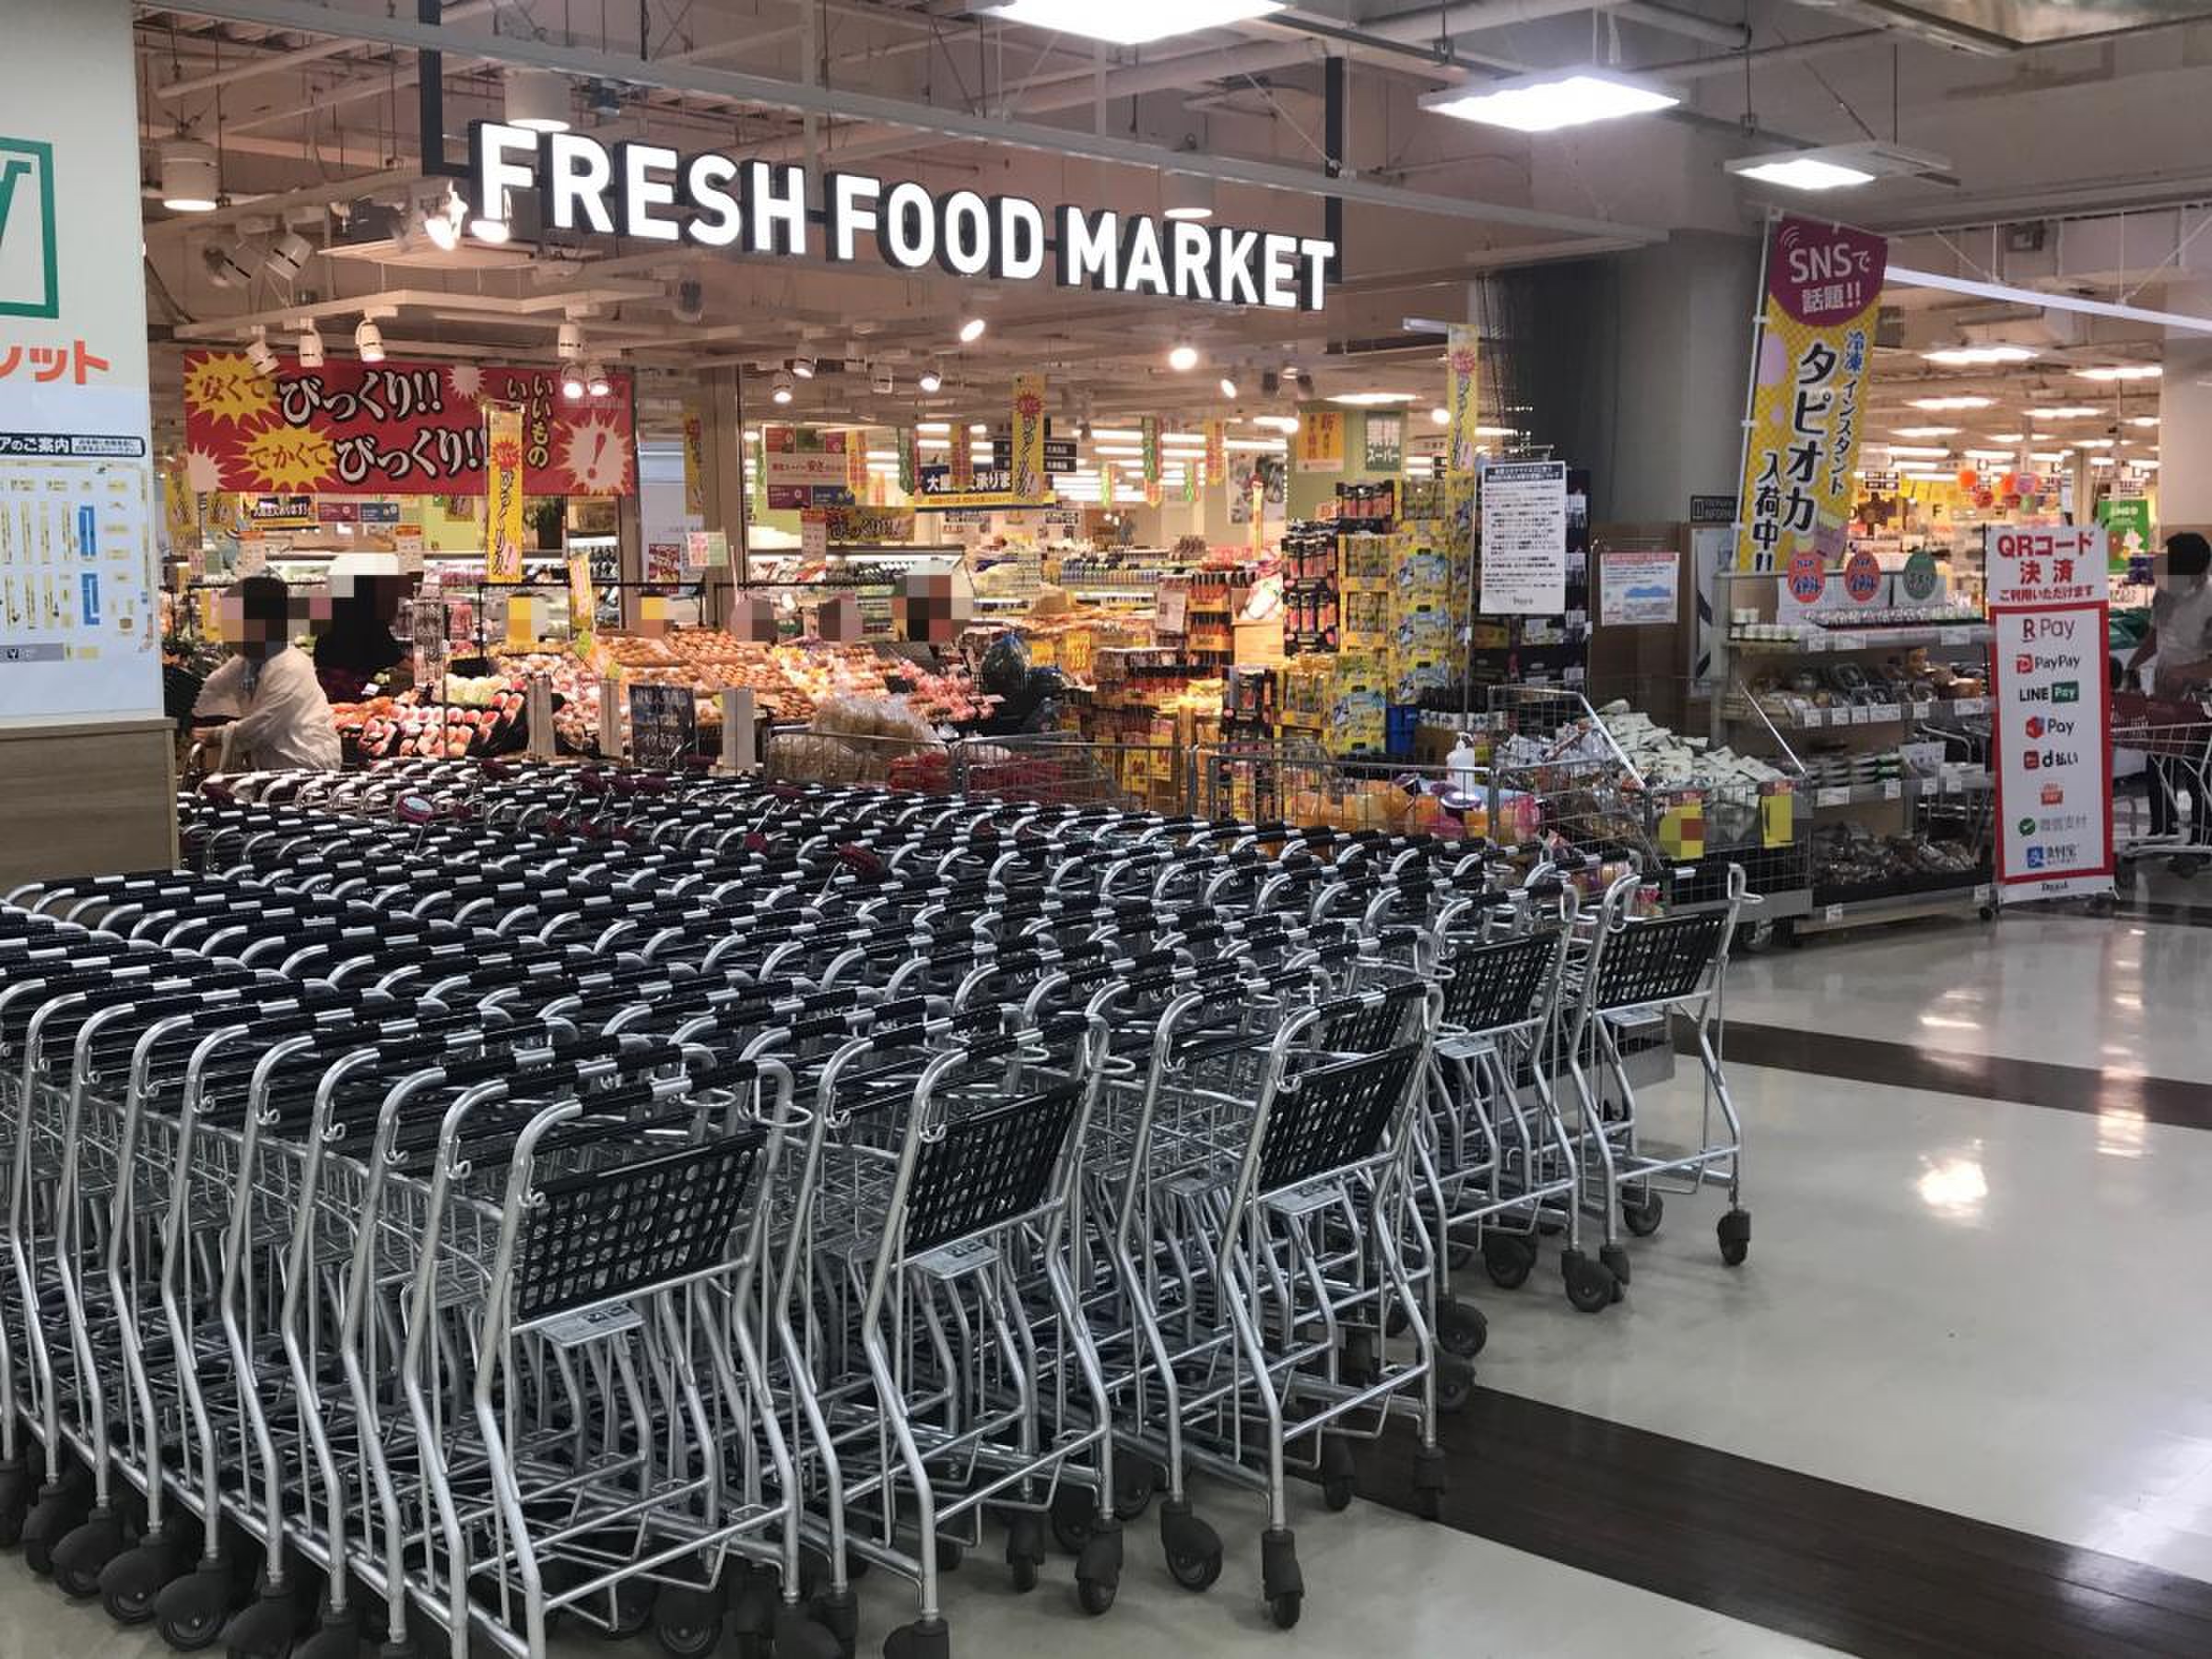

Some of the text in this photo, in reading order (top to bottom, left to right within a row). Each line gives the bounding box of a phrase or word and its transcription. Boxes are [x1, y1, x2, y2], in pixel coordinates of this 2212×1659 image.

[477, 122, 1335, 311] FRESH FOOD MARKET
[1789, 243, 1871, 283] SNSで
[1802, 280, 1861, 313] 話題!!
[279, 370, 441, 425] びっくり!!
[1783, 342, 1838, 533] タピオカ
[1753, 452, 1781, 571] 入荷中!!
[1997, 532, 2095, 559] QRコード
[1999, 584, 2095, 602] ご利用いただけます
[2040, 618, 2076, 640] Pay
[2034, 654, 2080, 671] PayPay
[2019, 688, 2049, 702] LINE
[2047, 718, 2075, 735] Pay
